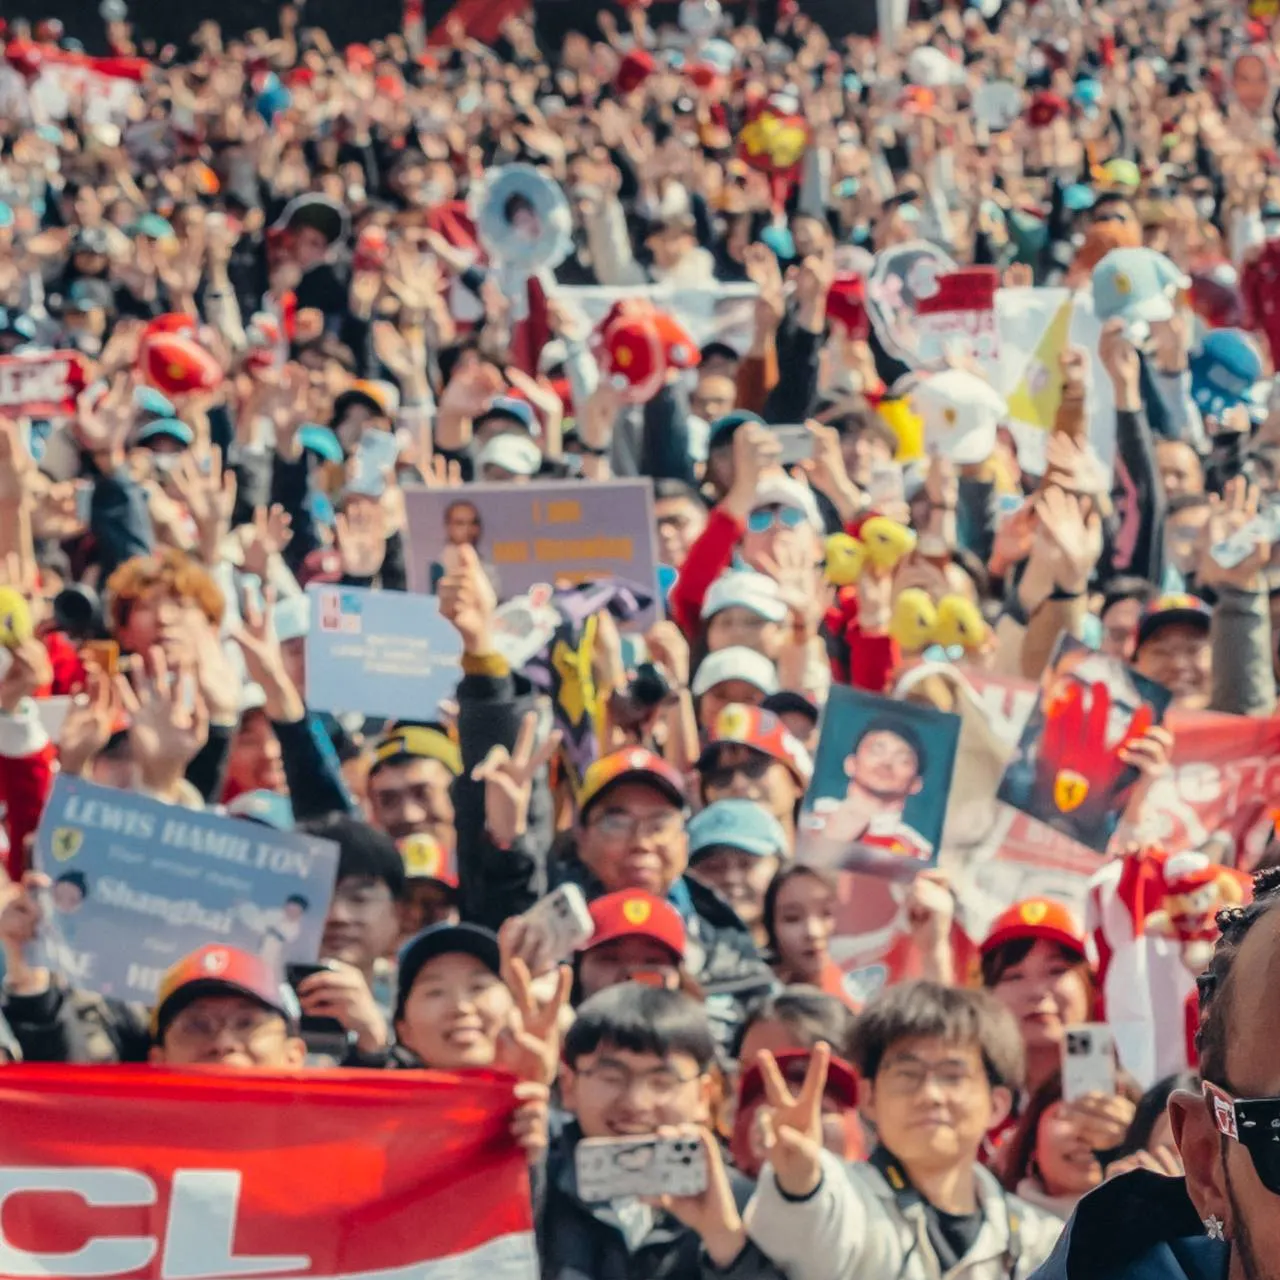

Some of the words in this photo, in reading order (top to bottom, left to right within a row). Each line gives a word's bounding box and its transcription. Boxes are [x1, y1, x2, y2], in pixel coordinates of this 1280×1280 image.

[63, 795, 155, 839] LEWIS
[160, 818, 316, 879] HAMILTON
[0, 1165, 310, 1279] CL
